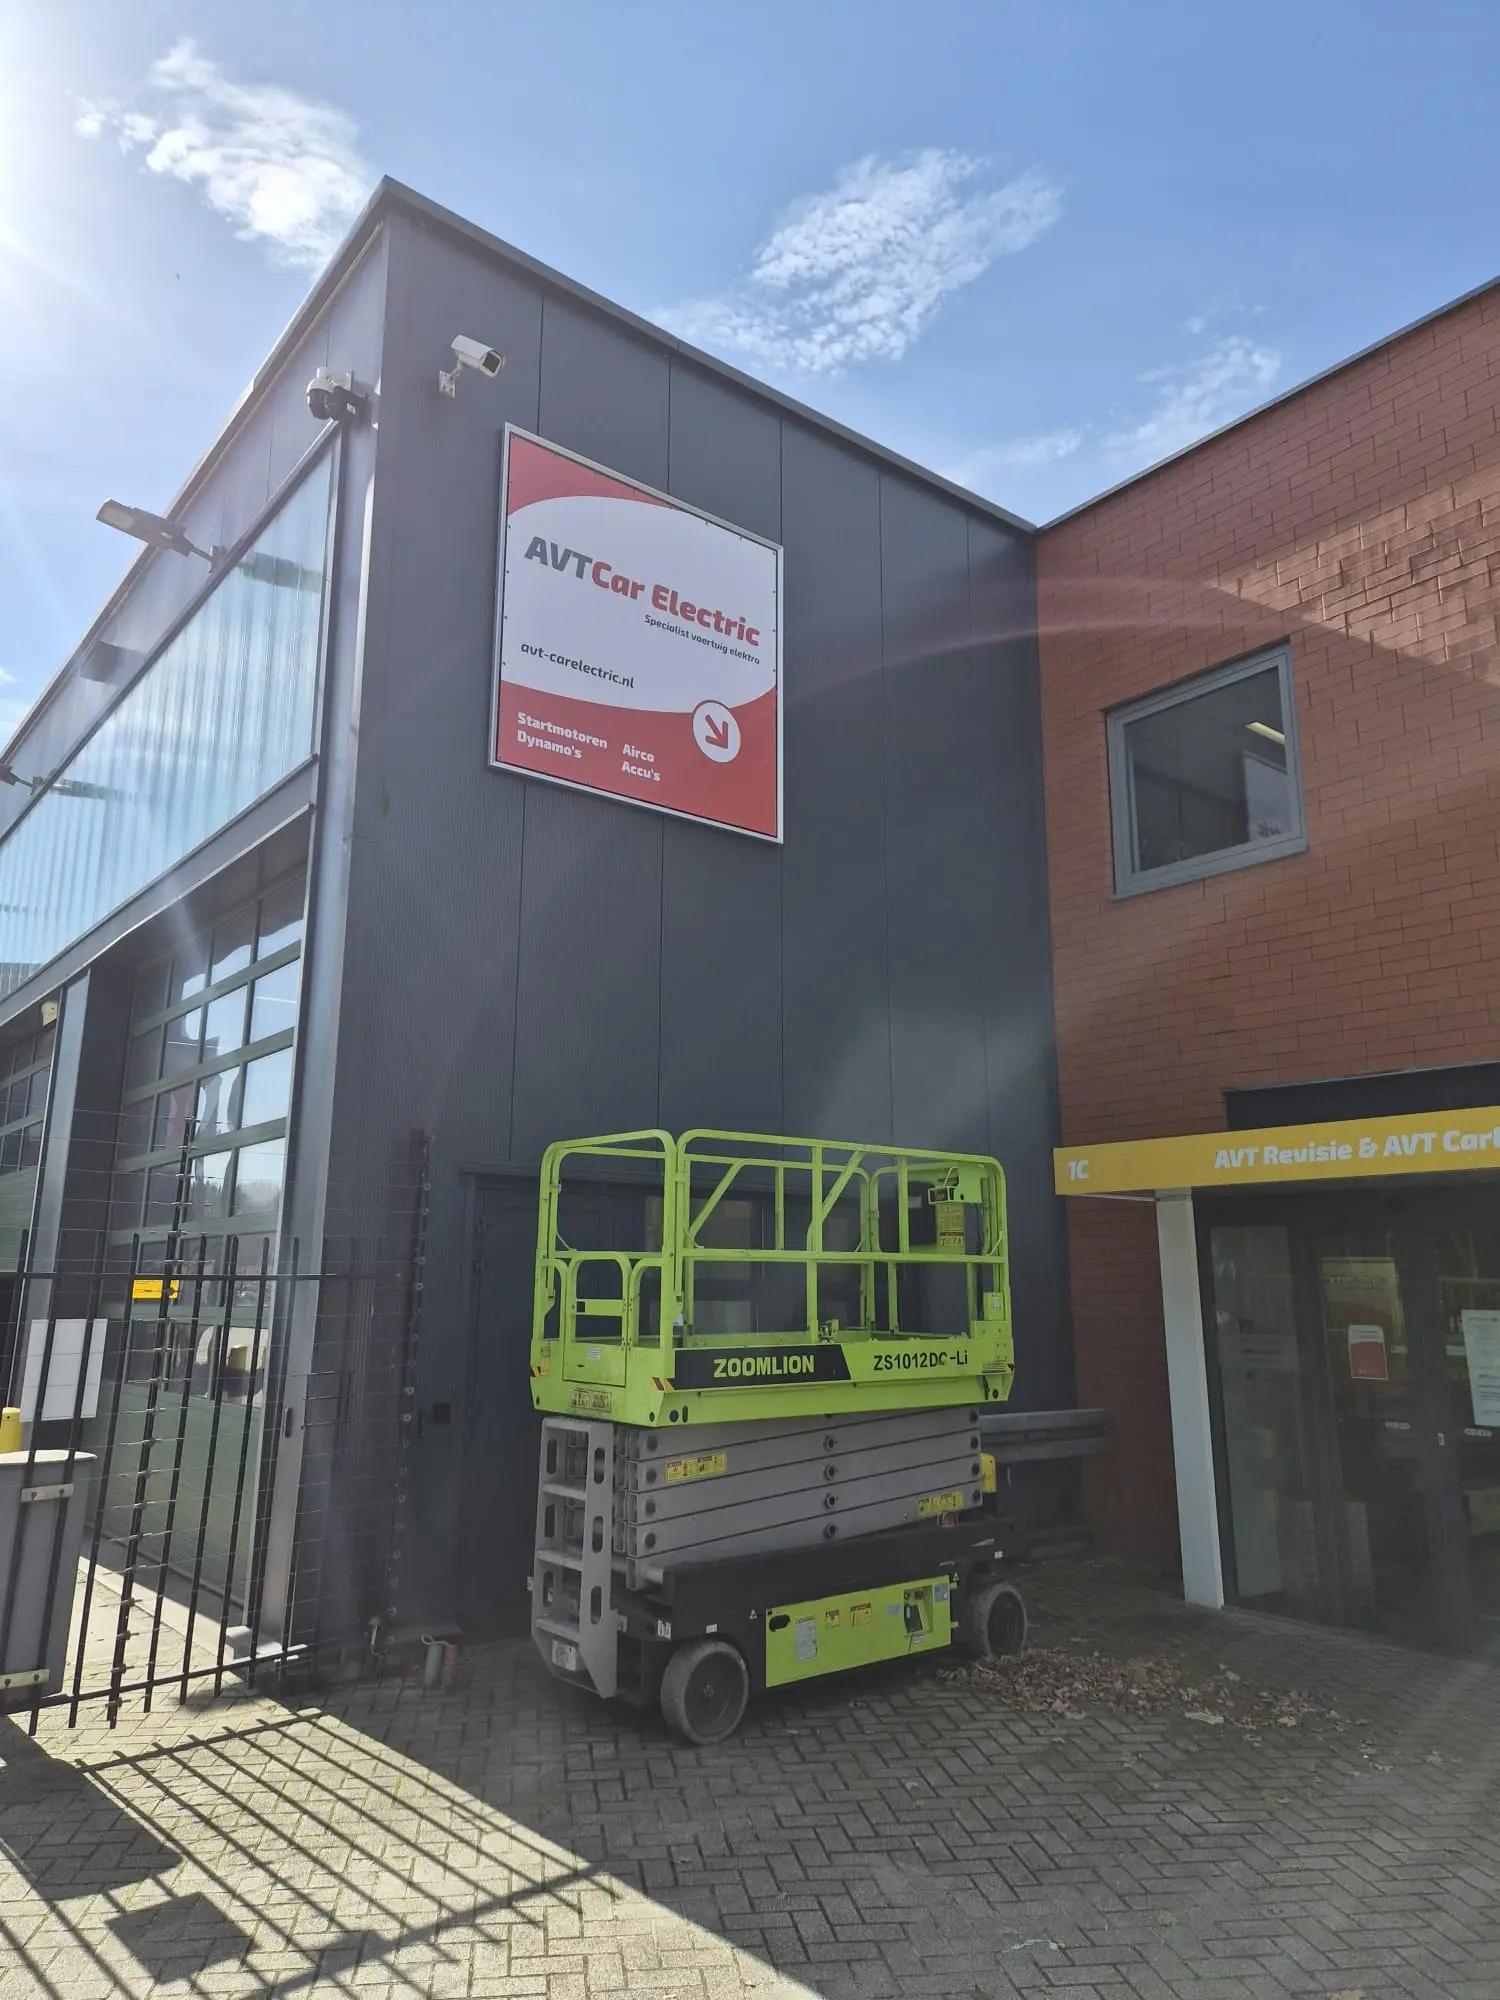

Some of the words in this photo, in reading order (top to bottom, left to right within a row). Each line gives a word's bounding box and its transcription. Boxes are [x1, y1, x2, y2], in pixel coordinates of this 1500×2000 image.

[651, 584, 760, 647] Electric
[644, 614, 690, 639] Specialist
[691, 633, 728, 655] voertuig
[729, 648, 760, 665] elektro
[520, 643, 635, 689] avt-carelectric.nl
[517, 711, 608, 749] Startmotoren
[517, 729, 582, 759] Dynamo's
[622, 743, 655, 763] Airco
[621, 760, 661, 782] Accu's
[1214, 1146, 1260, 1169] AVT
[1263, 1140, 1353, 1166] Revisie
[1358, 1137, 1378, 1159] &
[1383, 1132, 1438, 1157] AVT
[1067, 1160, 1089, 1180] 1C
[713, 1354, 816, 1378] ZOOMLION
